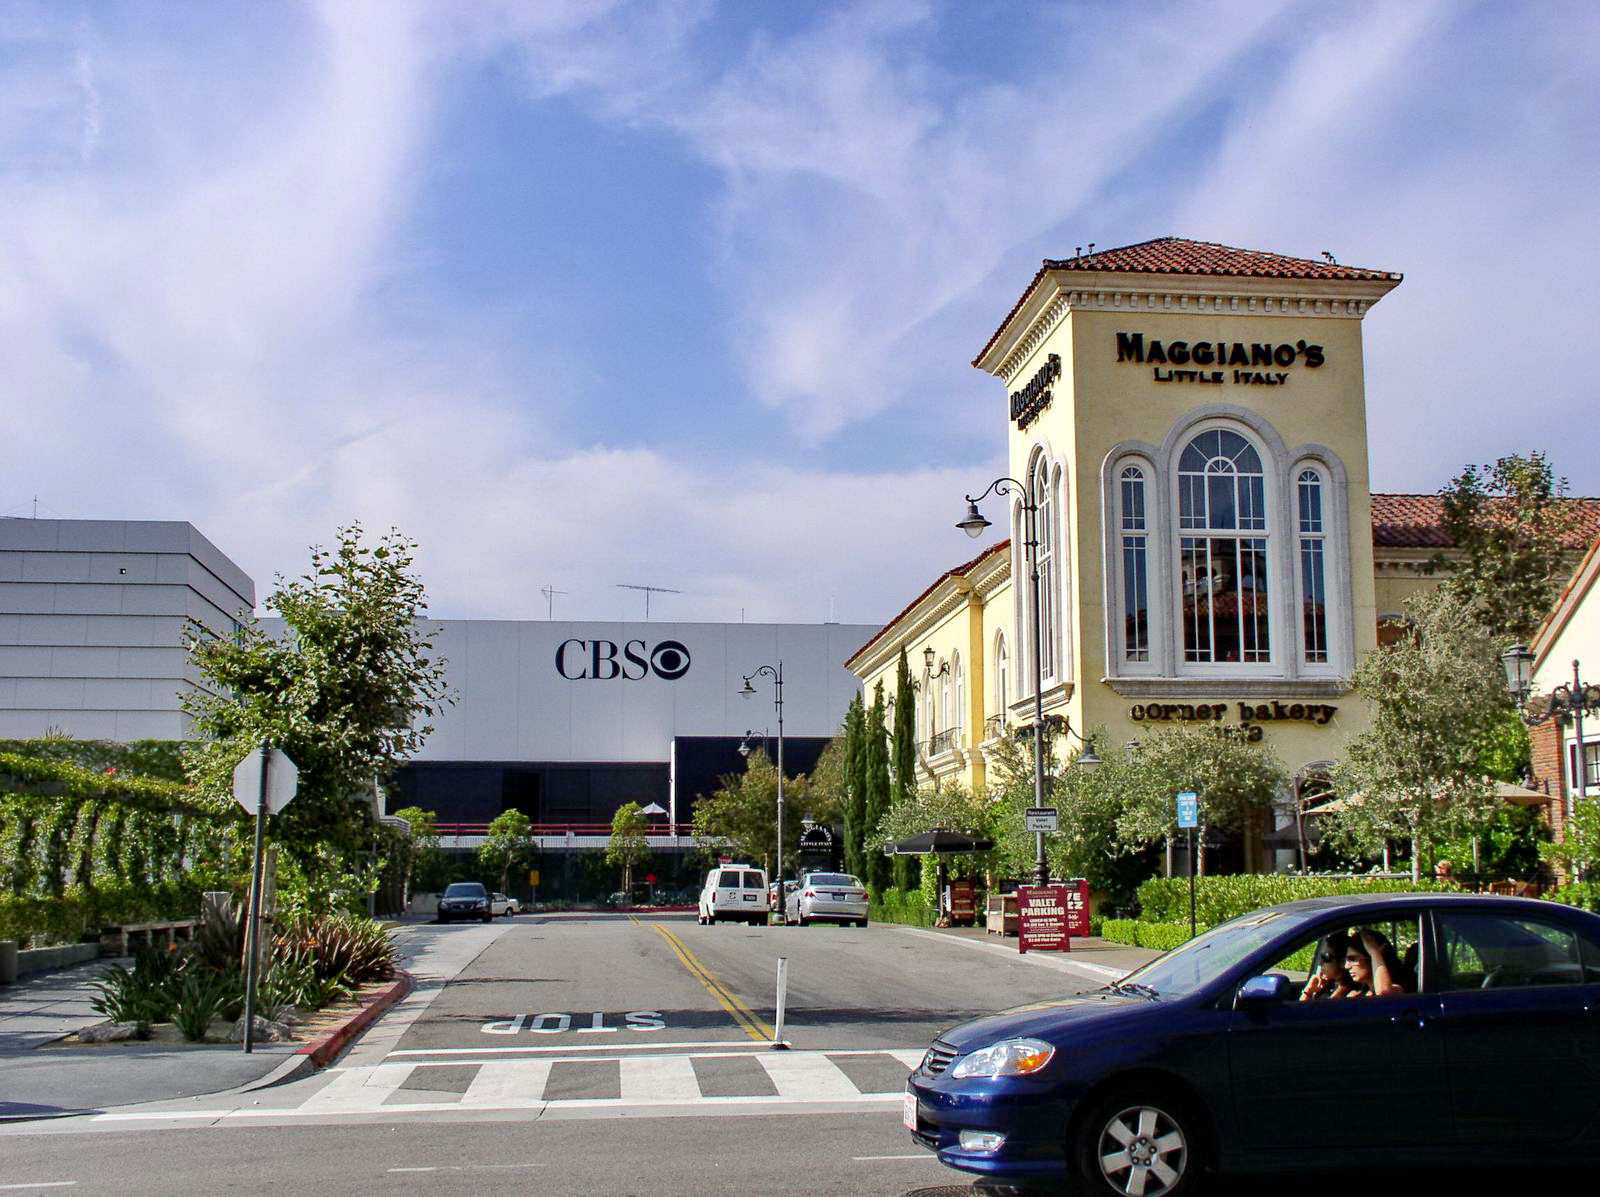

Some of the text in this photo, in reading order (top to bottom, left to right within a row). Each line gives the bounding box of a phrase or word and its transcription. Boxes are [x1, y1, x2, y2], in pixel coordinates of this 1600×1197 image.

[1116, 333, 1325, 368] MAGGIANO'S
[1154, 367, 1289, 385] LITTLE ITALY
[555, 638, 649, 681] CBS
[1130, 701, 1338, 724] corner bakery
[1021, 907, 1065, 917] PARKING
[1029, 898, 1056, 908] VALET
[480, 1010, 666, 1035] STOP
